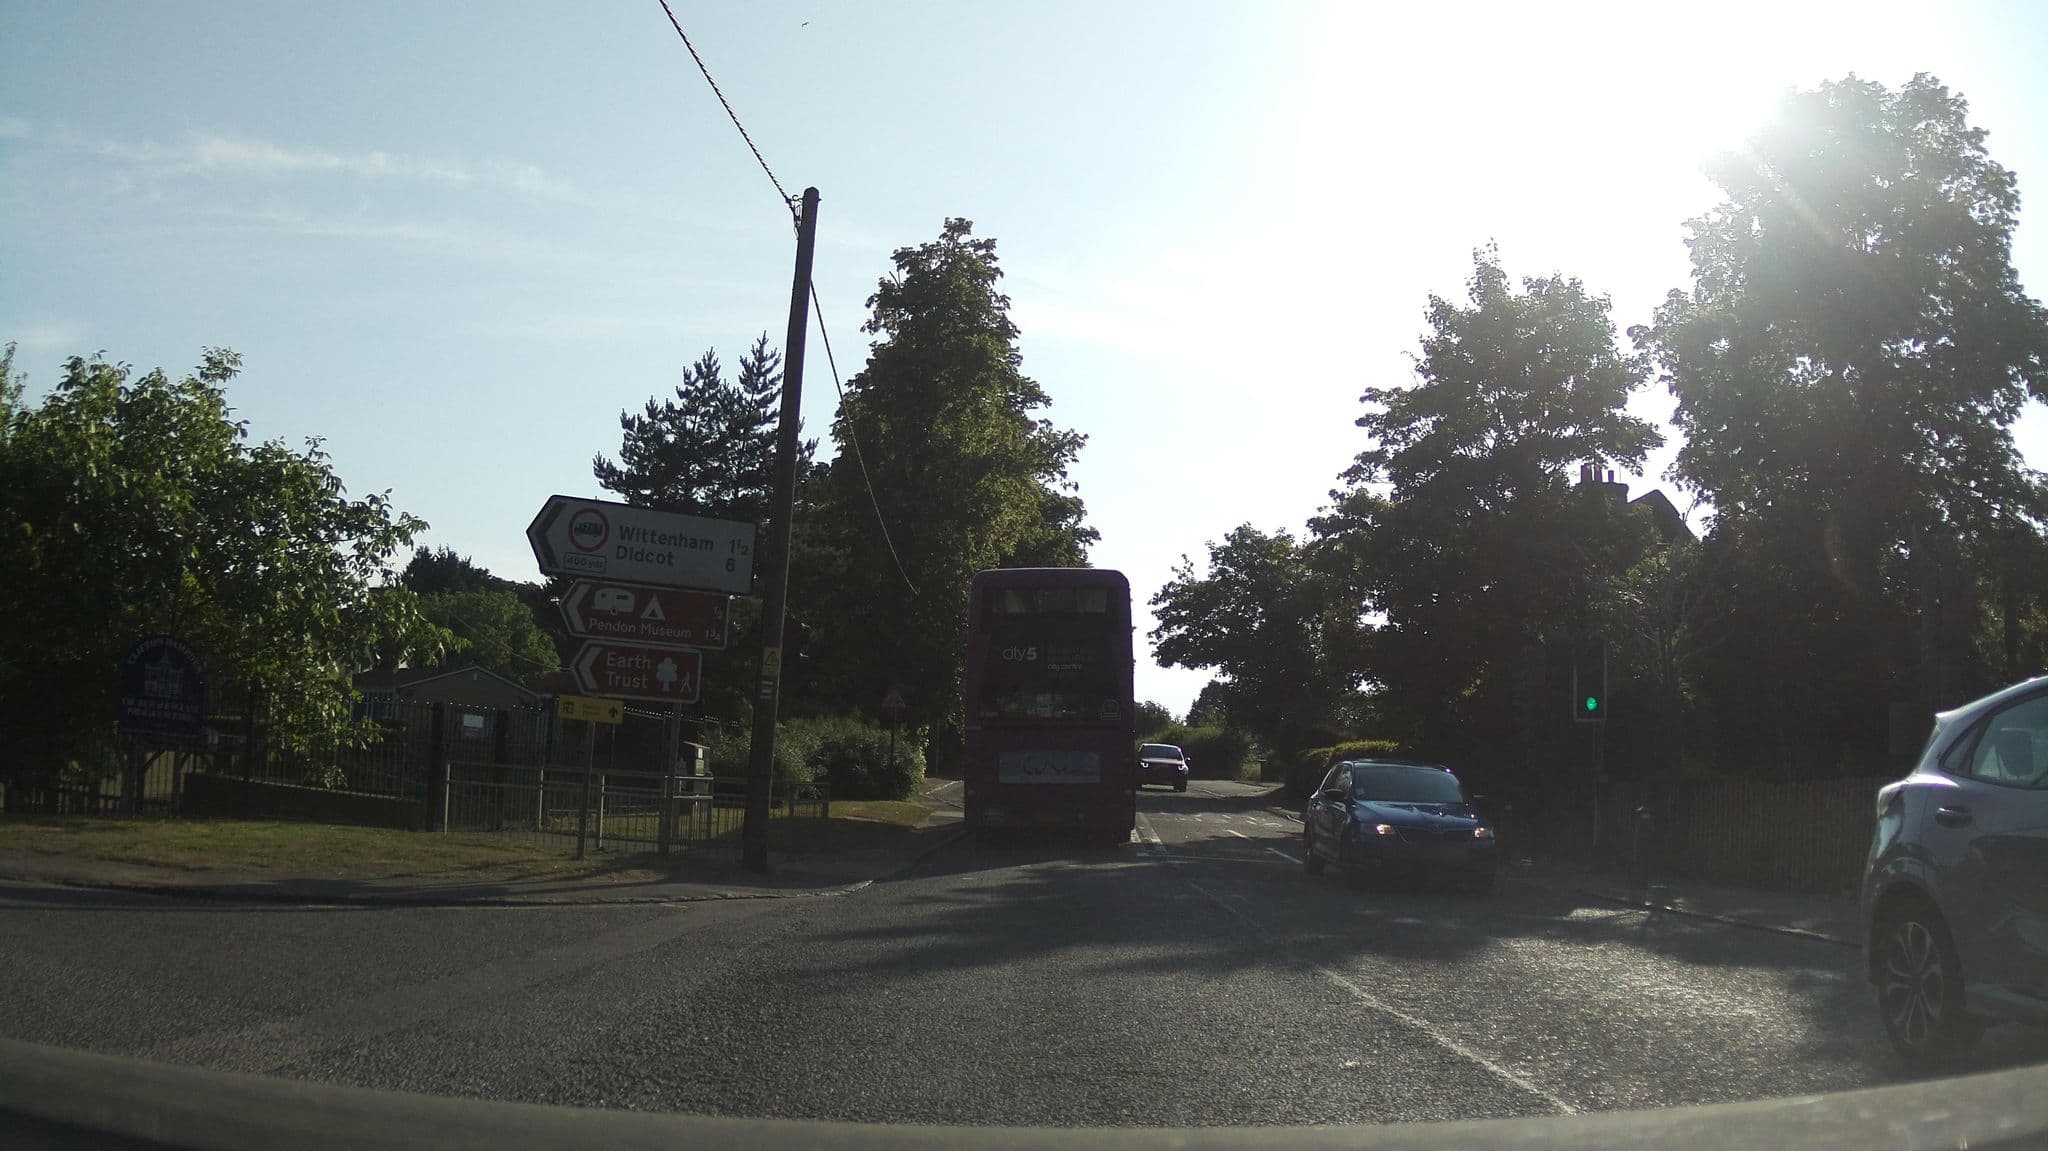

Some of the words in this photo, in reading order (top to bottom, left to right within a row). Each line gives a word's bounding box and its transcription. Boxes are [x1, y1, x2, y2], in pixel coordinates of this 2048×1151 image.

[619, 525, 714, 550] Wittenham
[615, 544, 674, 566] Didcot
[725, 558, 737, 573] 6
[589, 618, 636, 634] Pendon
[640, 623, 692, 639] Museum
[606, 652, 650, 672] Earth
[607, 671, 649, 689] Trust
